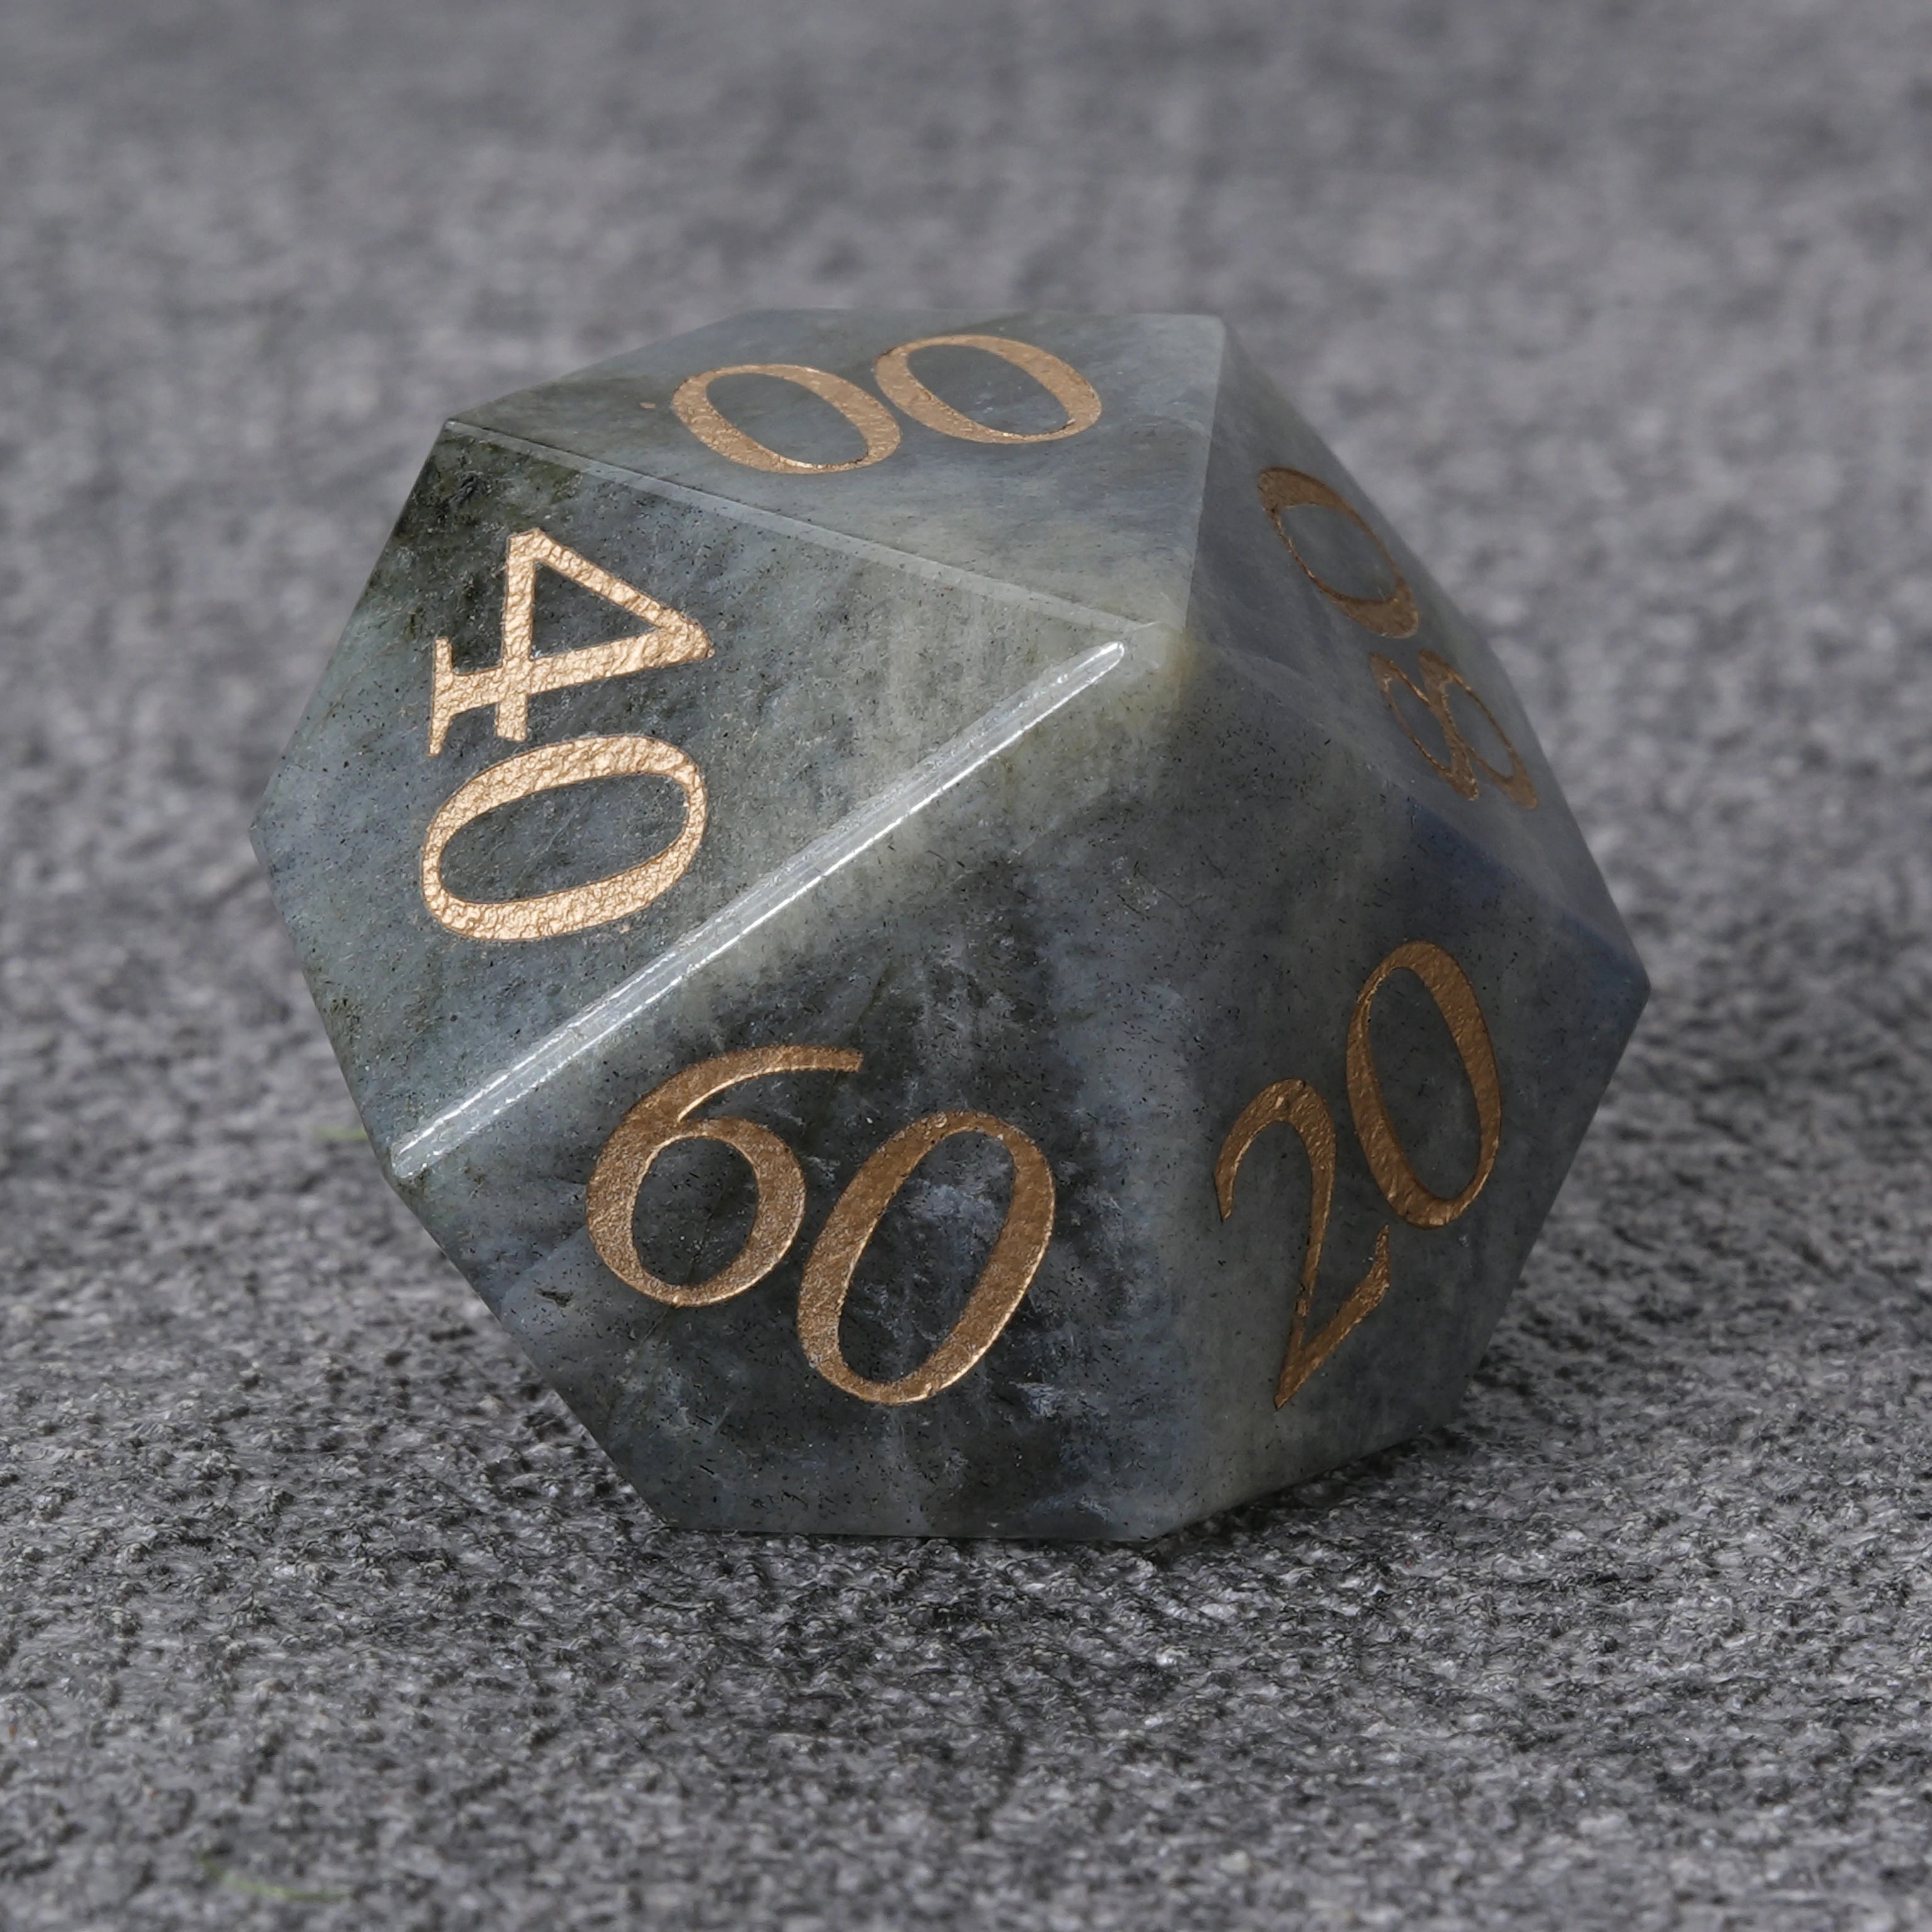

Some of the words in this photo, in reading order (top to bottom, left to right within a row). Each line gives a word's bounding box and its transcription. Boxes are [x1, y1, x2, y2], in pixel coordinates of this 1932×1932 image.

[672, 333, 1102, 474] 00
[421, 529, 715, 942] 40
[1257, 466, 1538, 809] 80
[586, 1044, 1057, 1406] 60
[1214, 941, 1503, 1407] 20
